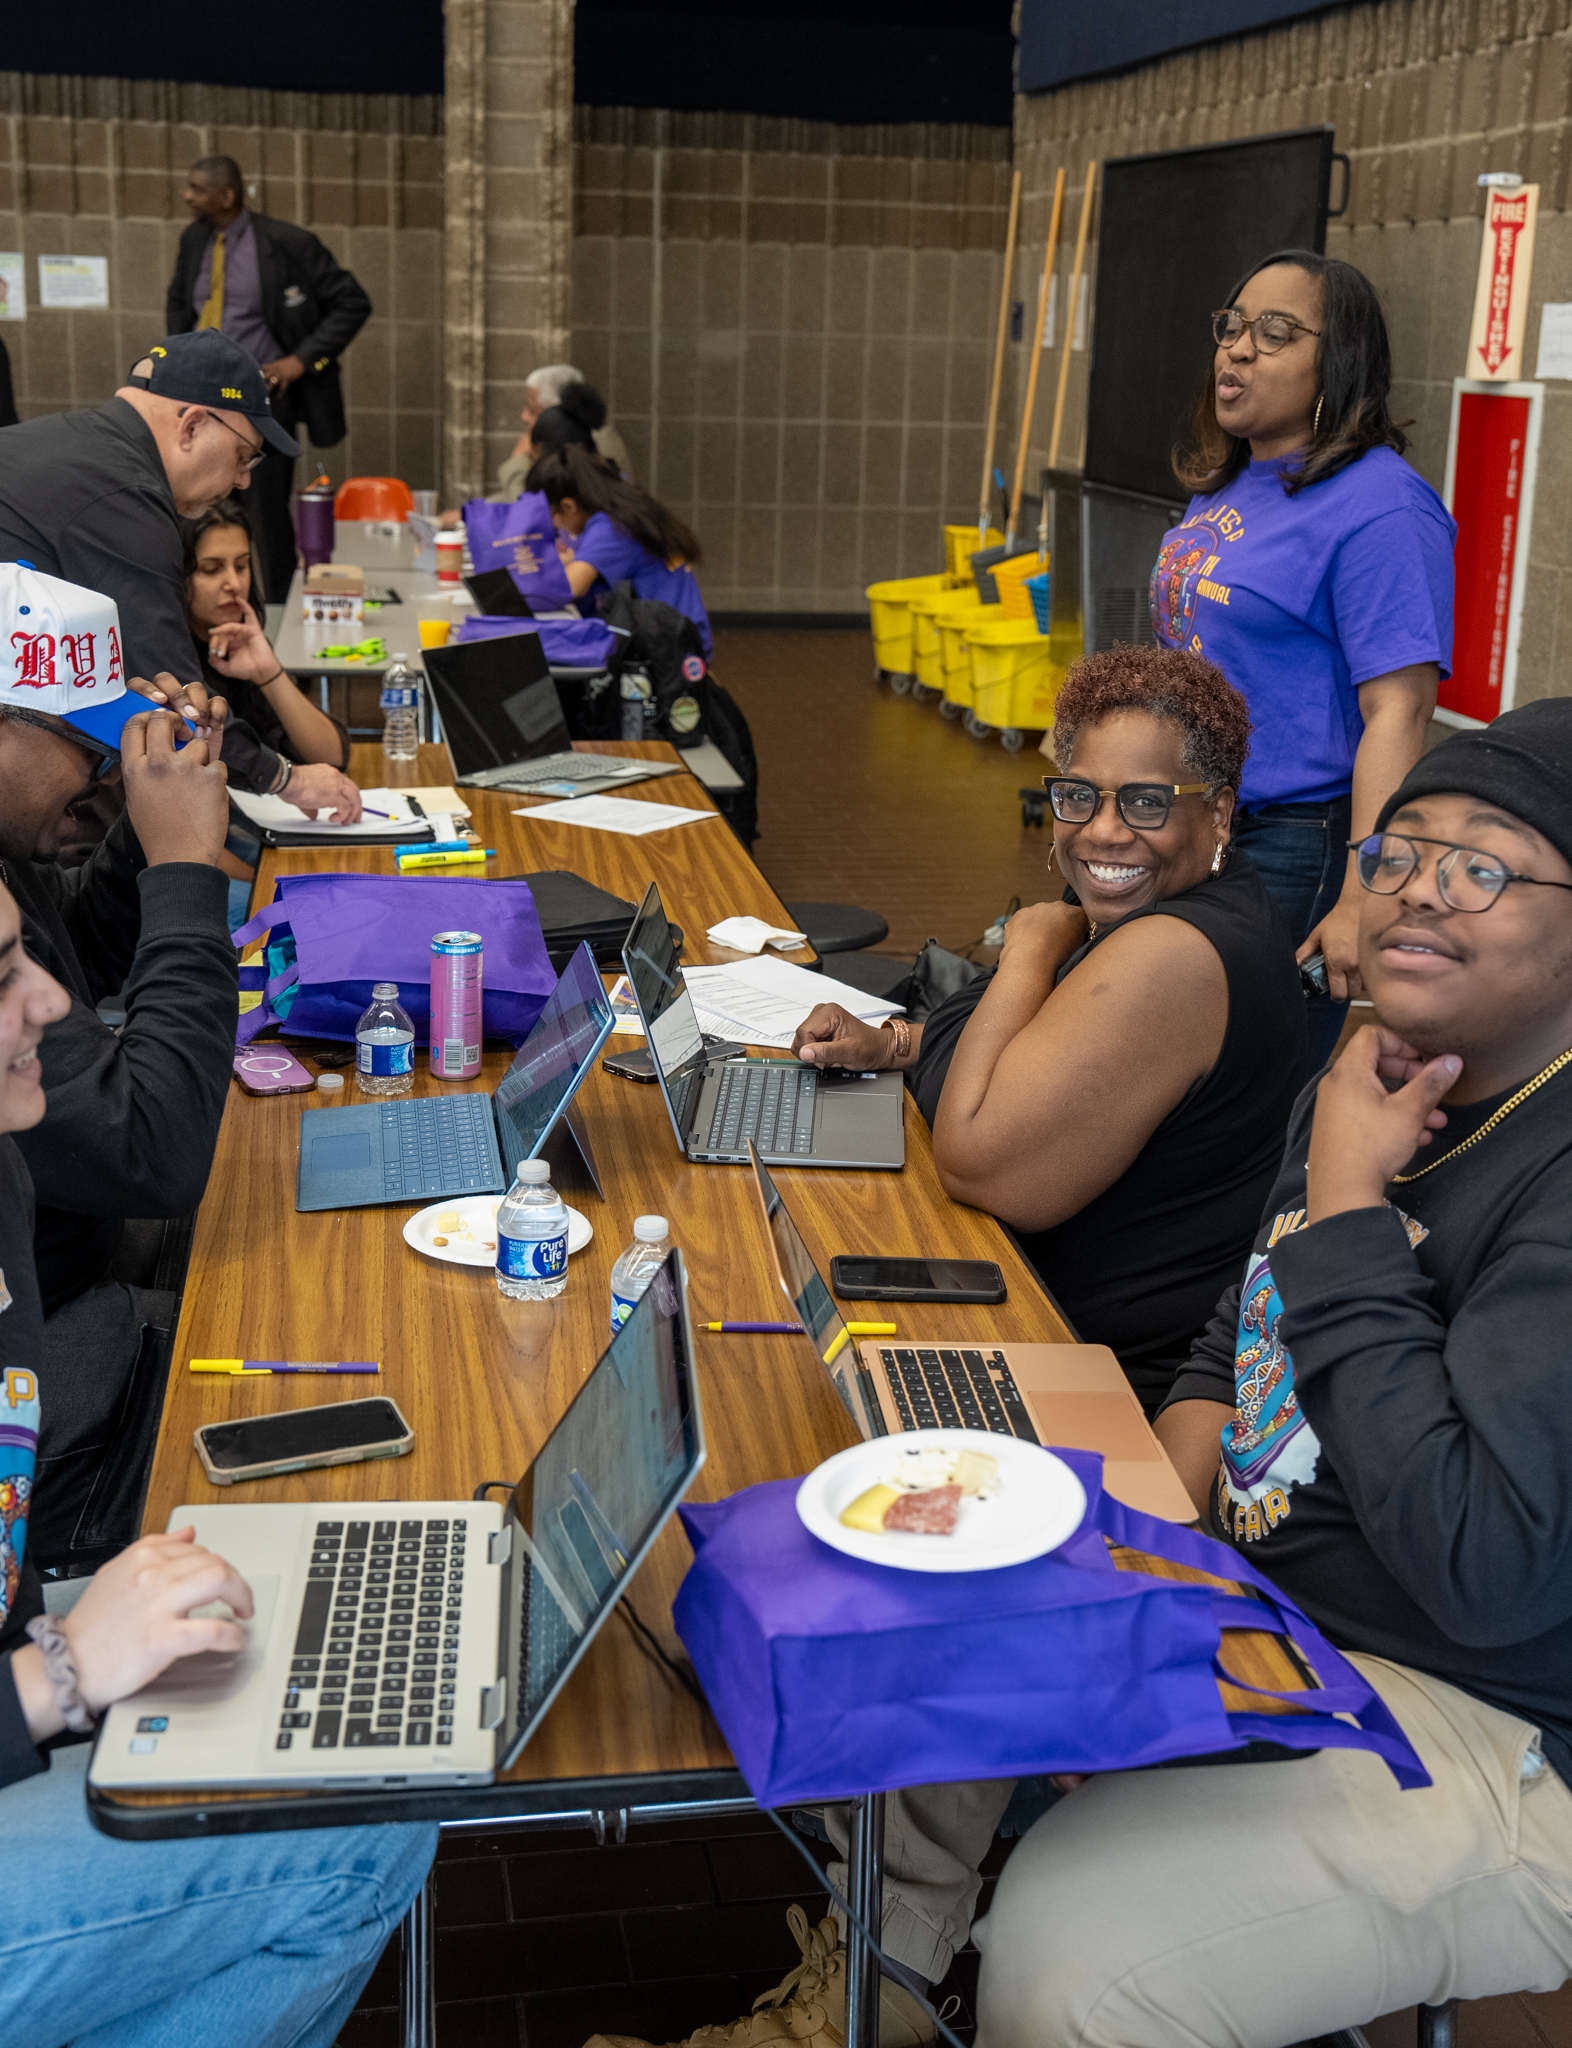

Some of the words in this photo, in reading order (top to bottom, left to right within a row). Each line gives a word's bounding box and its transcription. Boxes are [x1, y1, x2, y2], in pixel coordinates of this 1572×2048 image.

[1492, 202, 1525, 223] FIRE
[1487, 227, 1514, 366] EXTINGUISHER
[1196, 578, 1231, 606] ANNUAL
[540, 1238, 564, 1253] Pure
[543, 1249, 562, 1264] Life
[1234, 1487, 1291, 1542] FAIR
